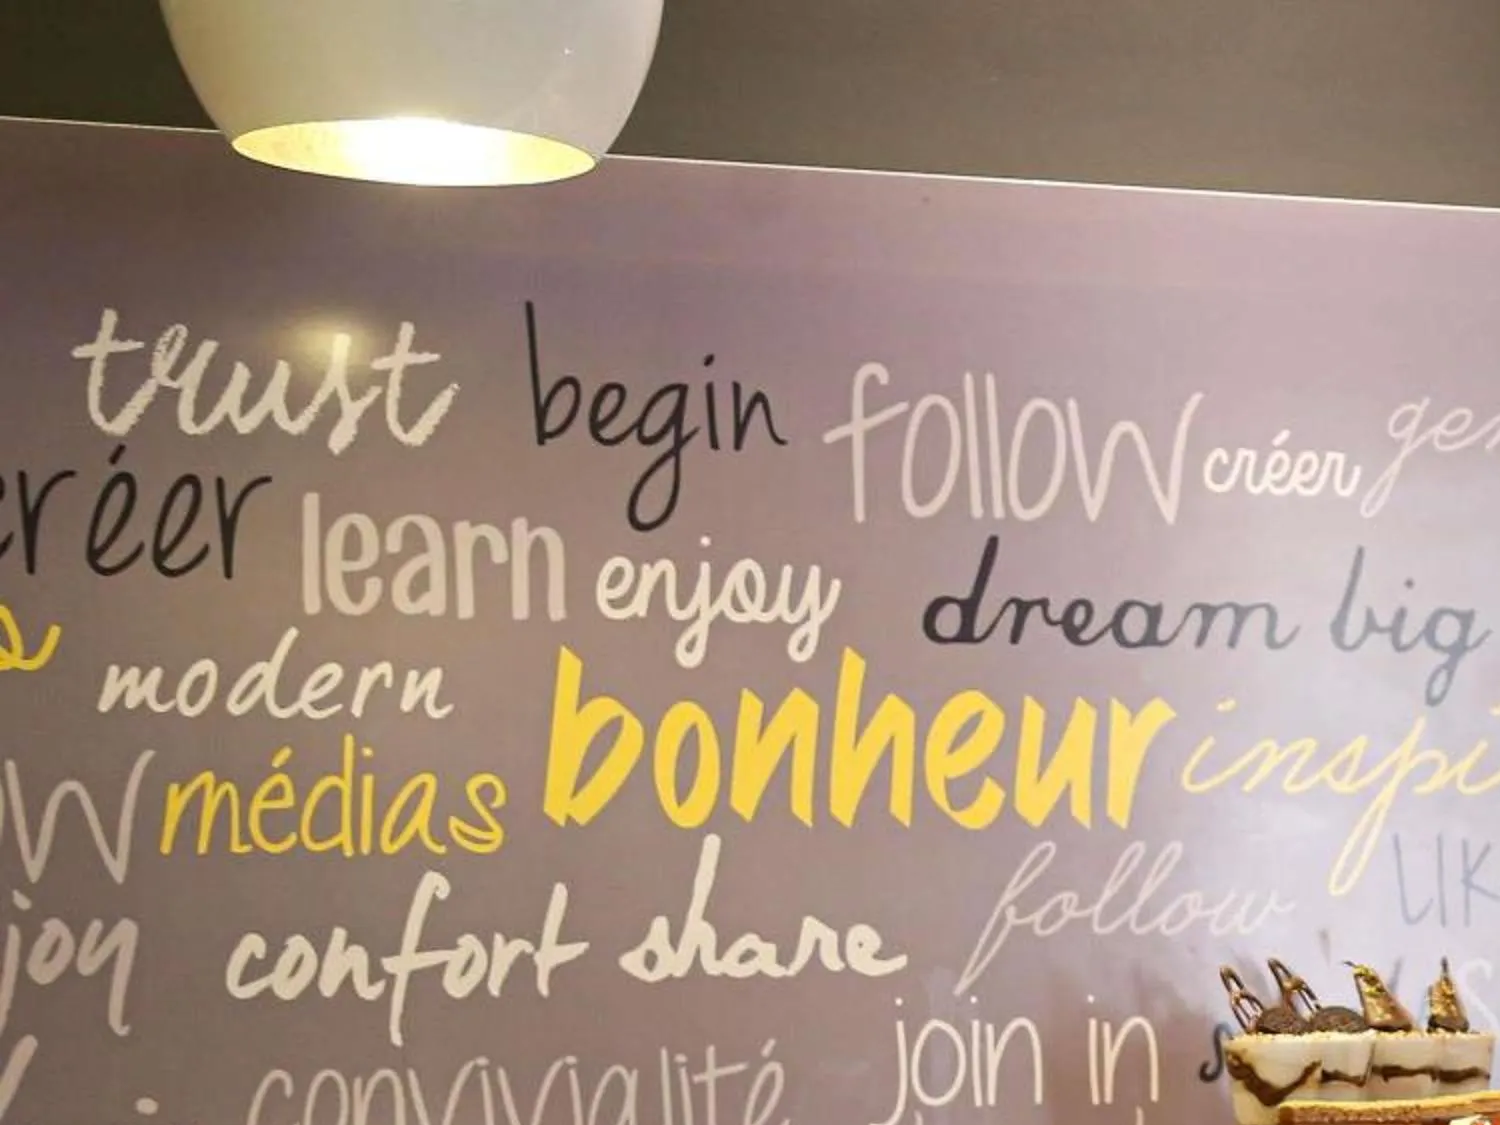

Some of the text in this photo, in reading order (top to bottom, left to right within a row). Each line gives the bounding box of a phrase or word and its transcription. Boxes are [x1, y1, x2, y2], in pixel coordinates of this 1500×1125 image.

[72, 308, 460, 454] trust
[526, 301, 788, 532] begin
[1204, 430, 1362, 497] créer
[302, 493, 567, 621] learn
[596, 536, 841, 668] enjoy
[923, 536, 1493, 707] dream big
[98, 627, 454, 719] modern
[543, 645, 1177, 830] bonheur
[160, 733, 508, 857] médias
[225, 834, 908, 1047] confort share
[954, 840, 1297, 998] follow
[1089, 994, 1160, 1106] in
